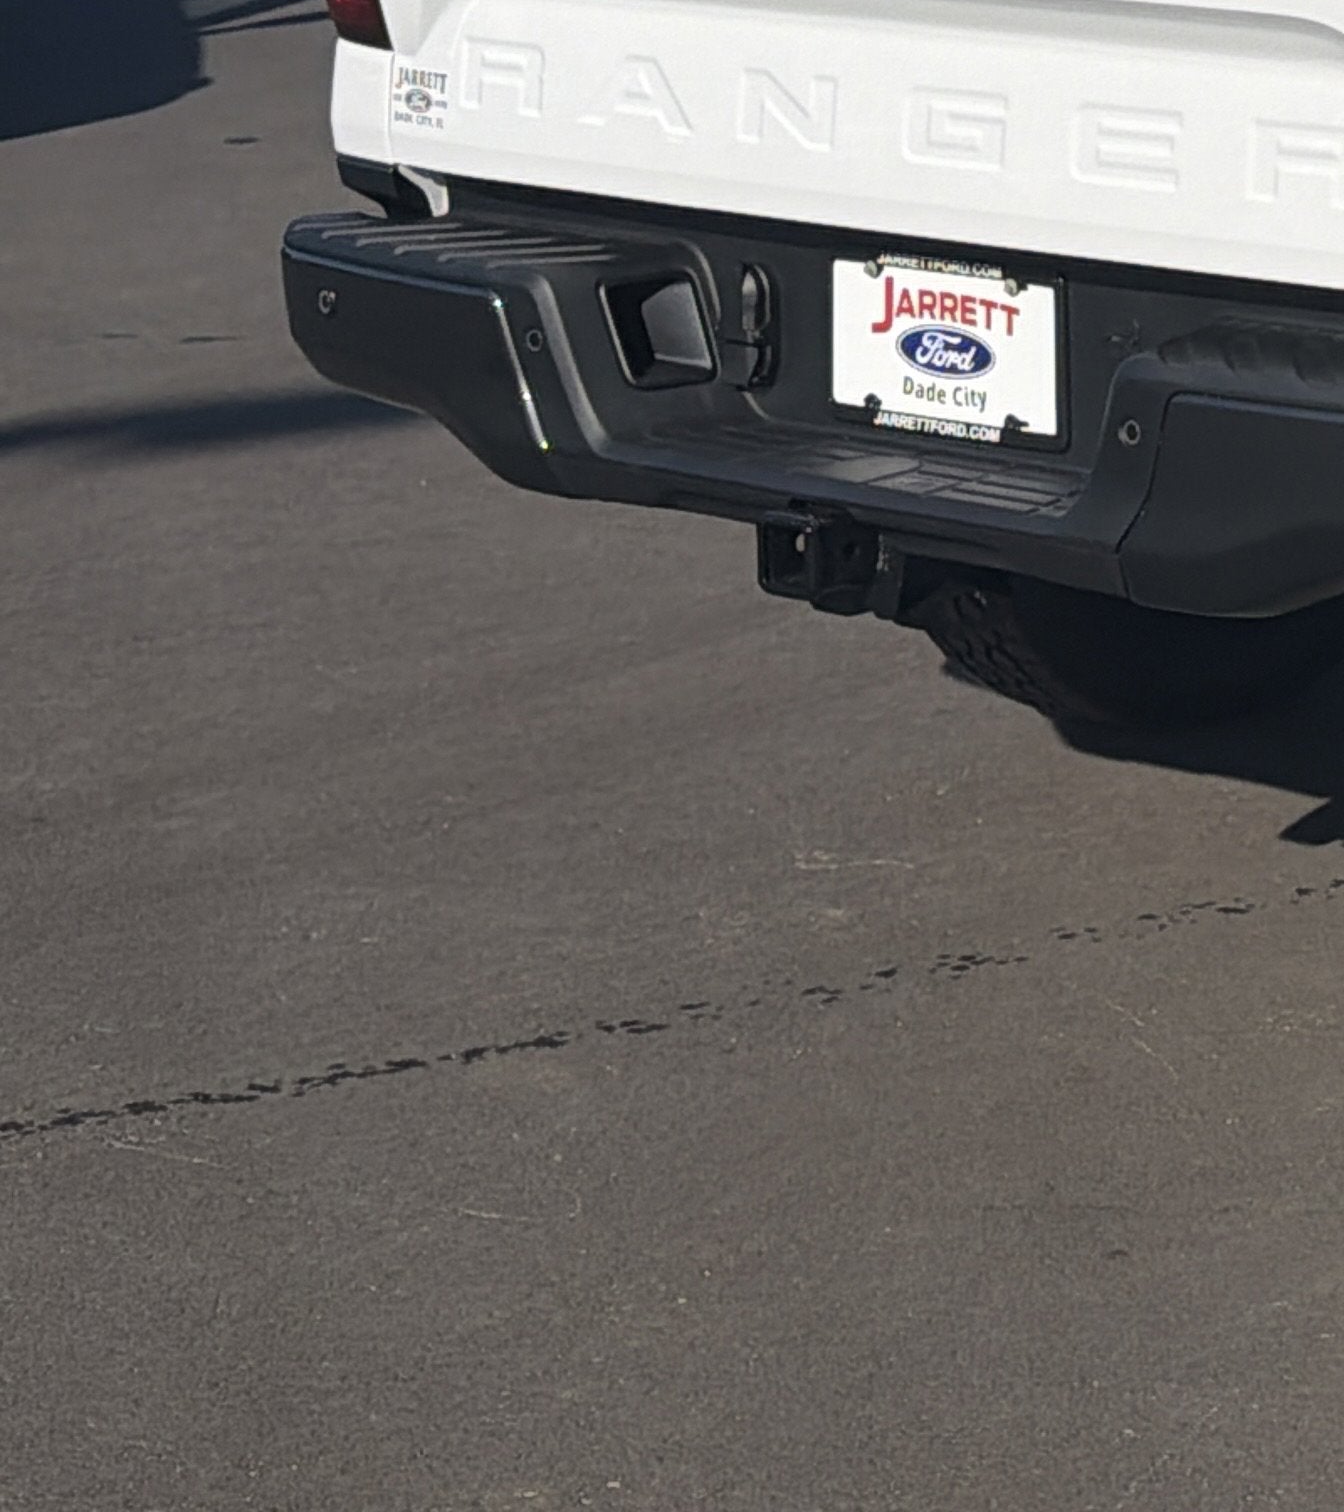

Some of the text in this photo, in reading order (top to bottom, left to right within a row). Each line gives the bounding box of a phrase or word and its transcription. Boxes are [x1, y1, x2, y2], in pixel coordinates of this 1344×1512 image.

[395, 66, 448, 95] JARRETT
[877, 251, 1003, 279] JARRETTFORD.COM
[872, 276, 1020, 337] JARRETT
[914, 332, 977, 372] Ford
[903, 375, 988, 413] Dade City
[873, 410, 1001, 443] JARRETTFORD.COM
